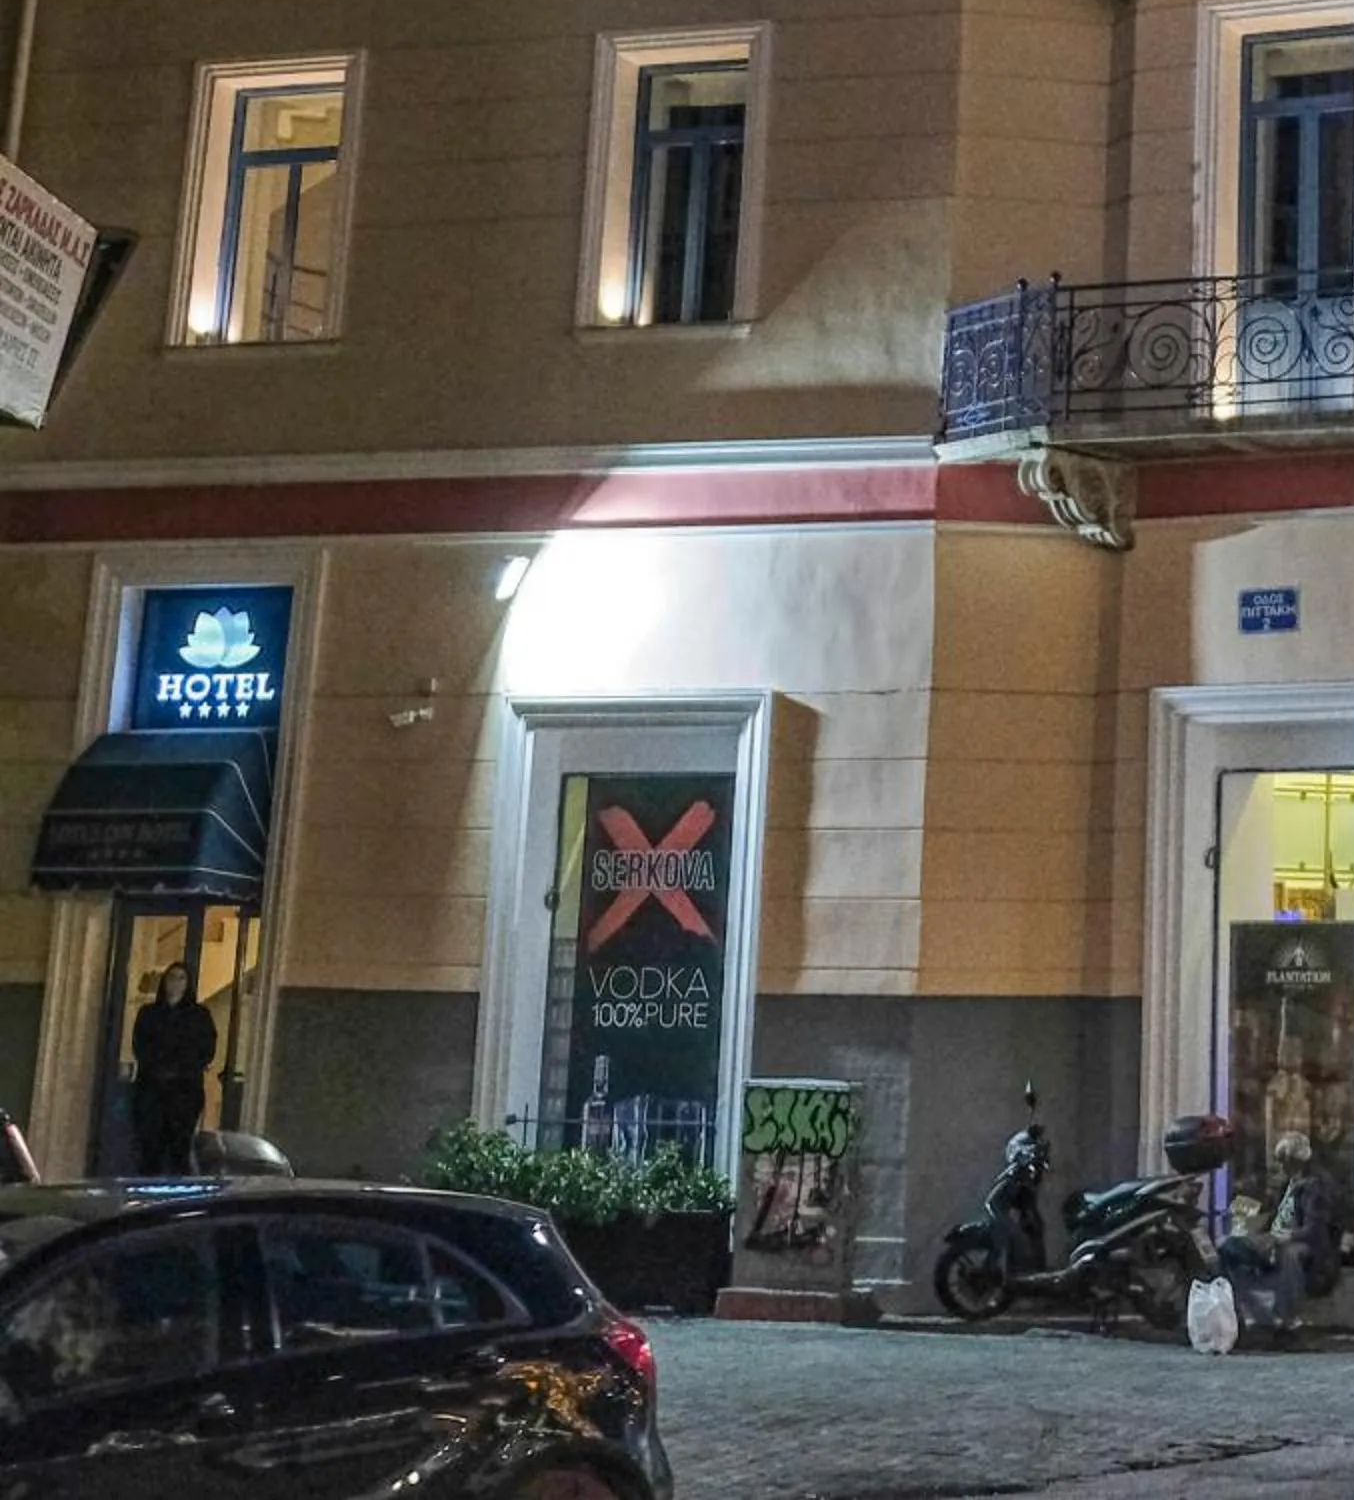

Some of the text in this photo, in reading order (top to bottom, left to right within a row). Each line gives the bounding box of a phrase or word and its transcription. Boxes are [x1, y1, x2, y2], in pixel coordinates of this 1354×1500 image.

[156, 673, 275, 702] HOTEL
[592, 850, 715, 891] SERKOVA
[589, 965, 710, 1000] VODKA
[1266, 970, 1332, 985] PLANTATION
[592, 1003, 708, 1029] 100% PURE
